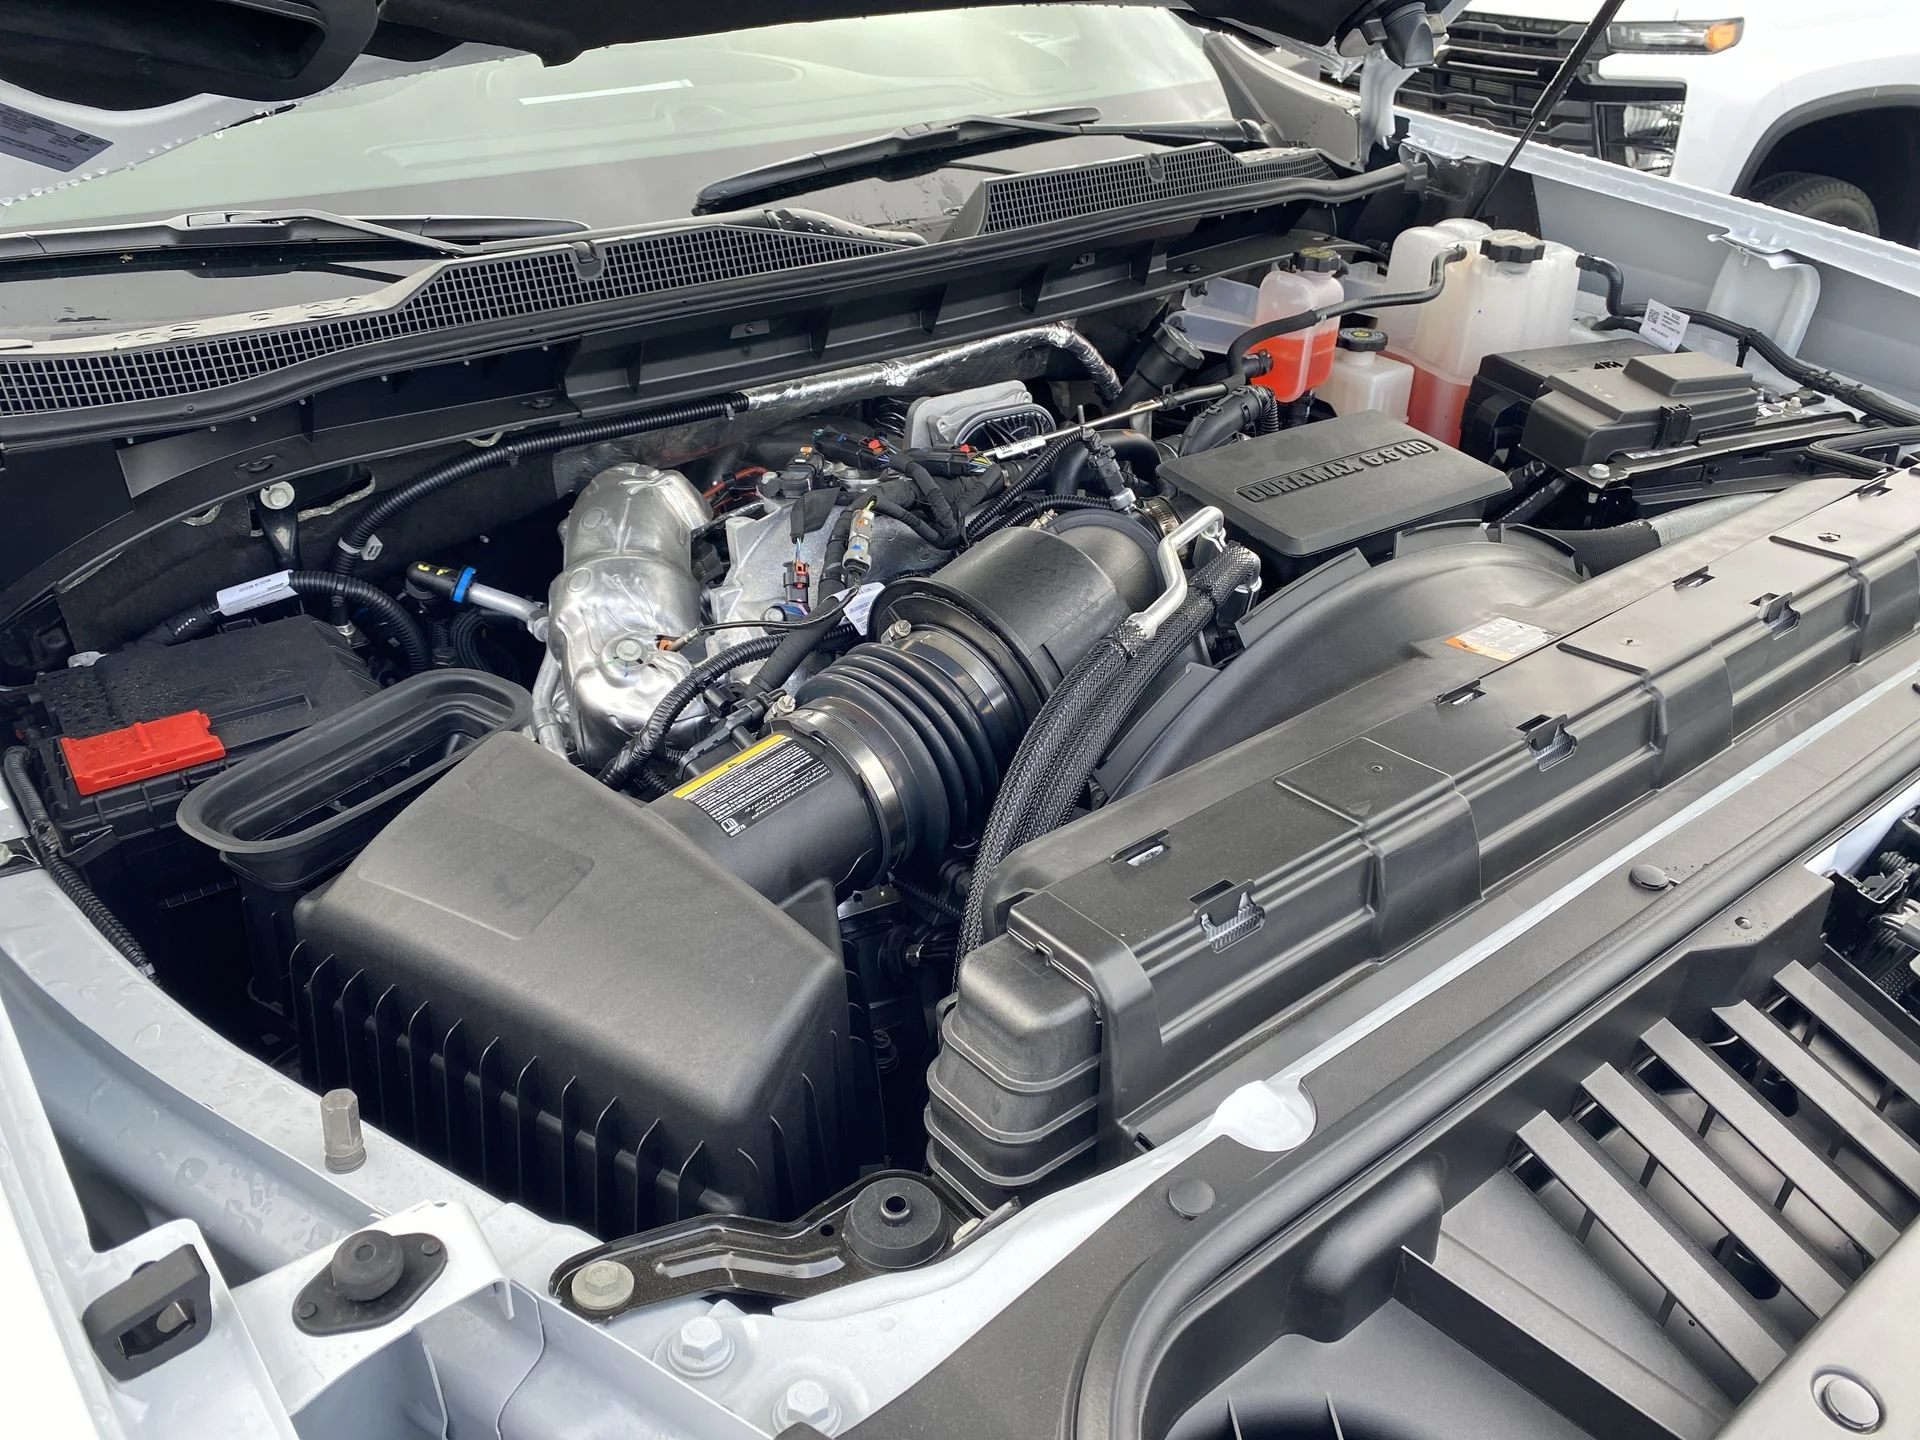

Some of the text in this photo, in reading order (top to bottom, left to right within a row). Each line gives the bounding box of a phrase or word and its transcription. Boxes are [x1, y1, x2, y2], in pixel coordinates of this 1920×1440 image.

[1242, 440, 1434, 503] DURAMAX 6.6 HD
